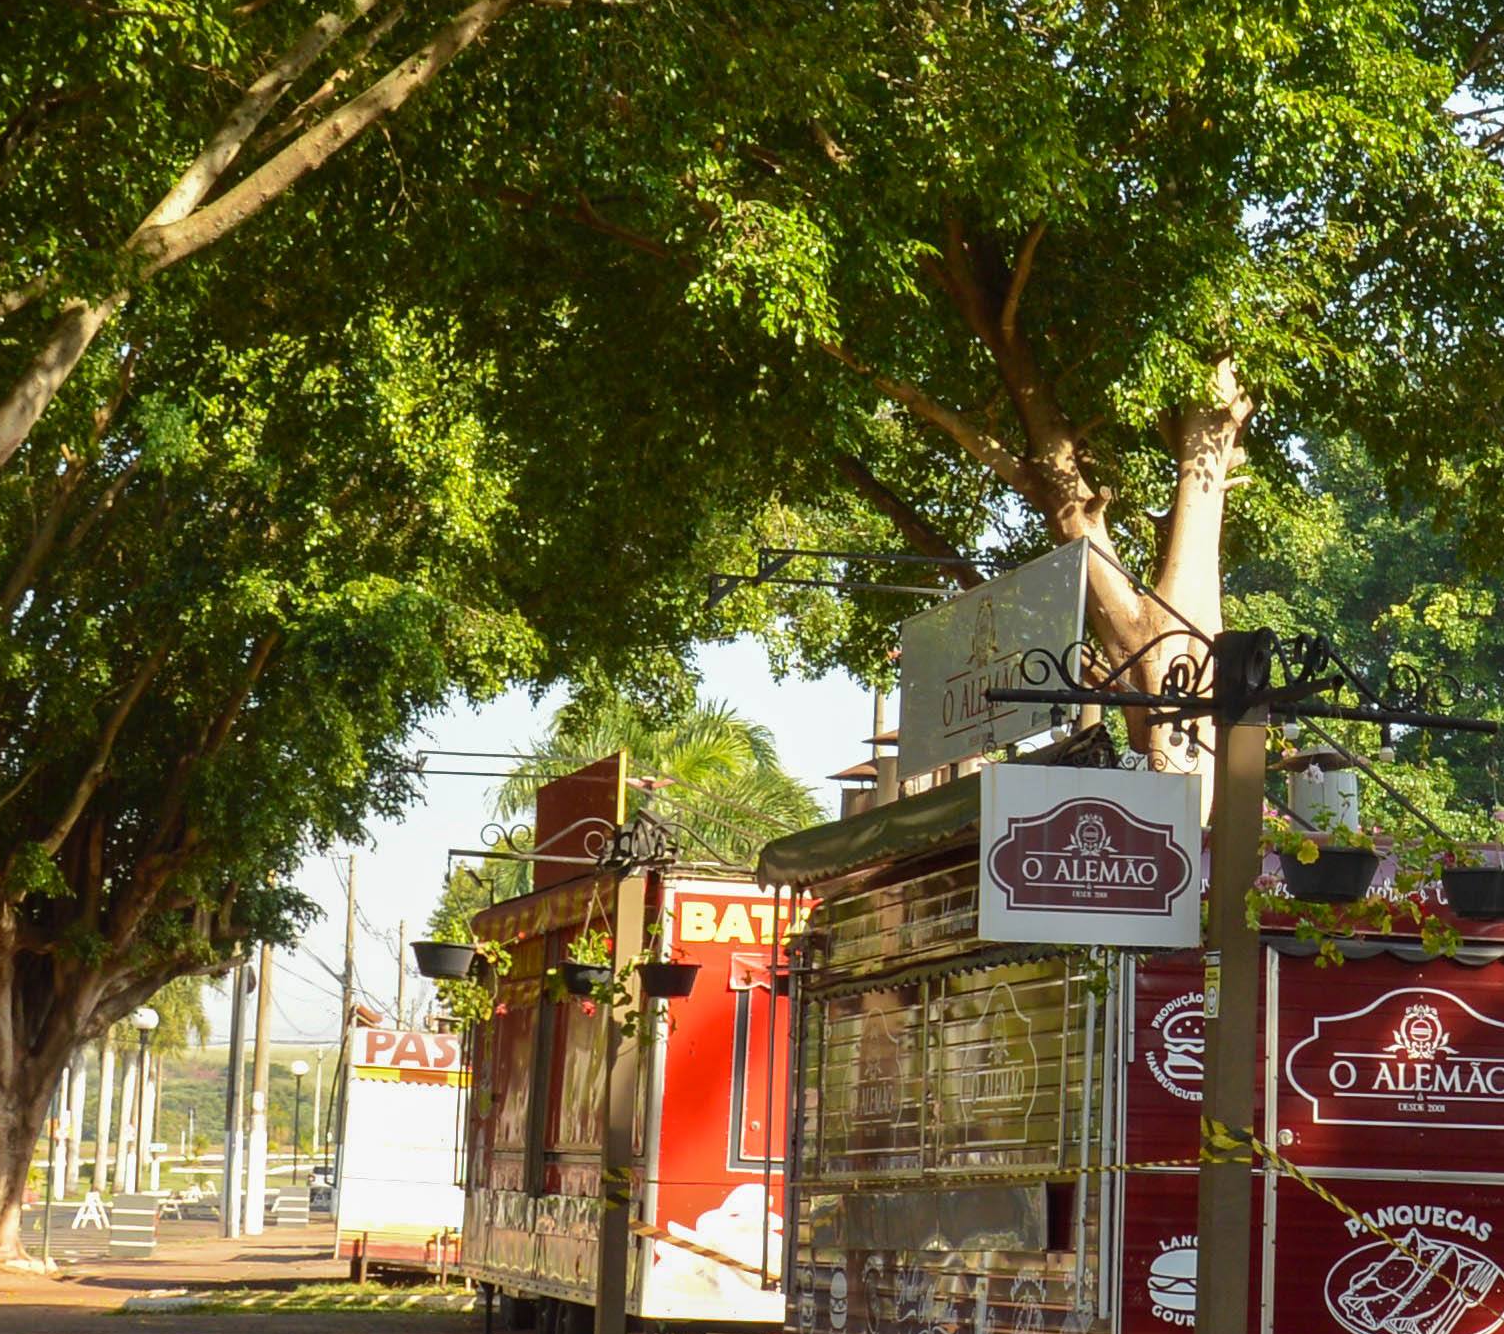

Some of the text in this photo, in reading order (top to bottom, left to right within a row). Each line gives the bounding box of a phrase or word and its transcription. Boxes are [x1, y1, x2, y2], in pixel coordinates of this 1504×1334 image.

[1022, 857, 1158, 885] O ALEMÃO
[1151, 992, 1204, 1029] PRODUÇÃO
[1328, 1061, 1357, 1089] O
[1344, 1205, 1492, 1242] PANQUECAS
[1151, 1304, 1196, 1327] GOUR
